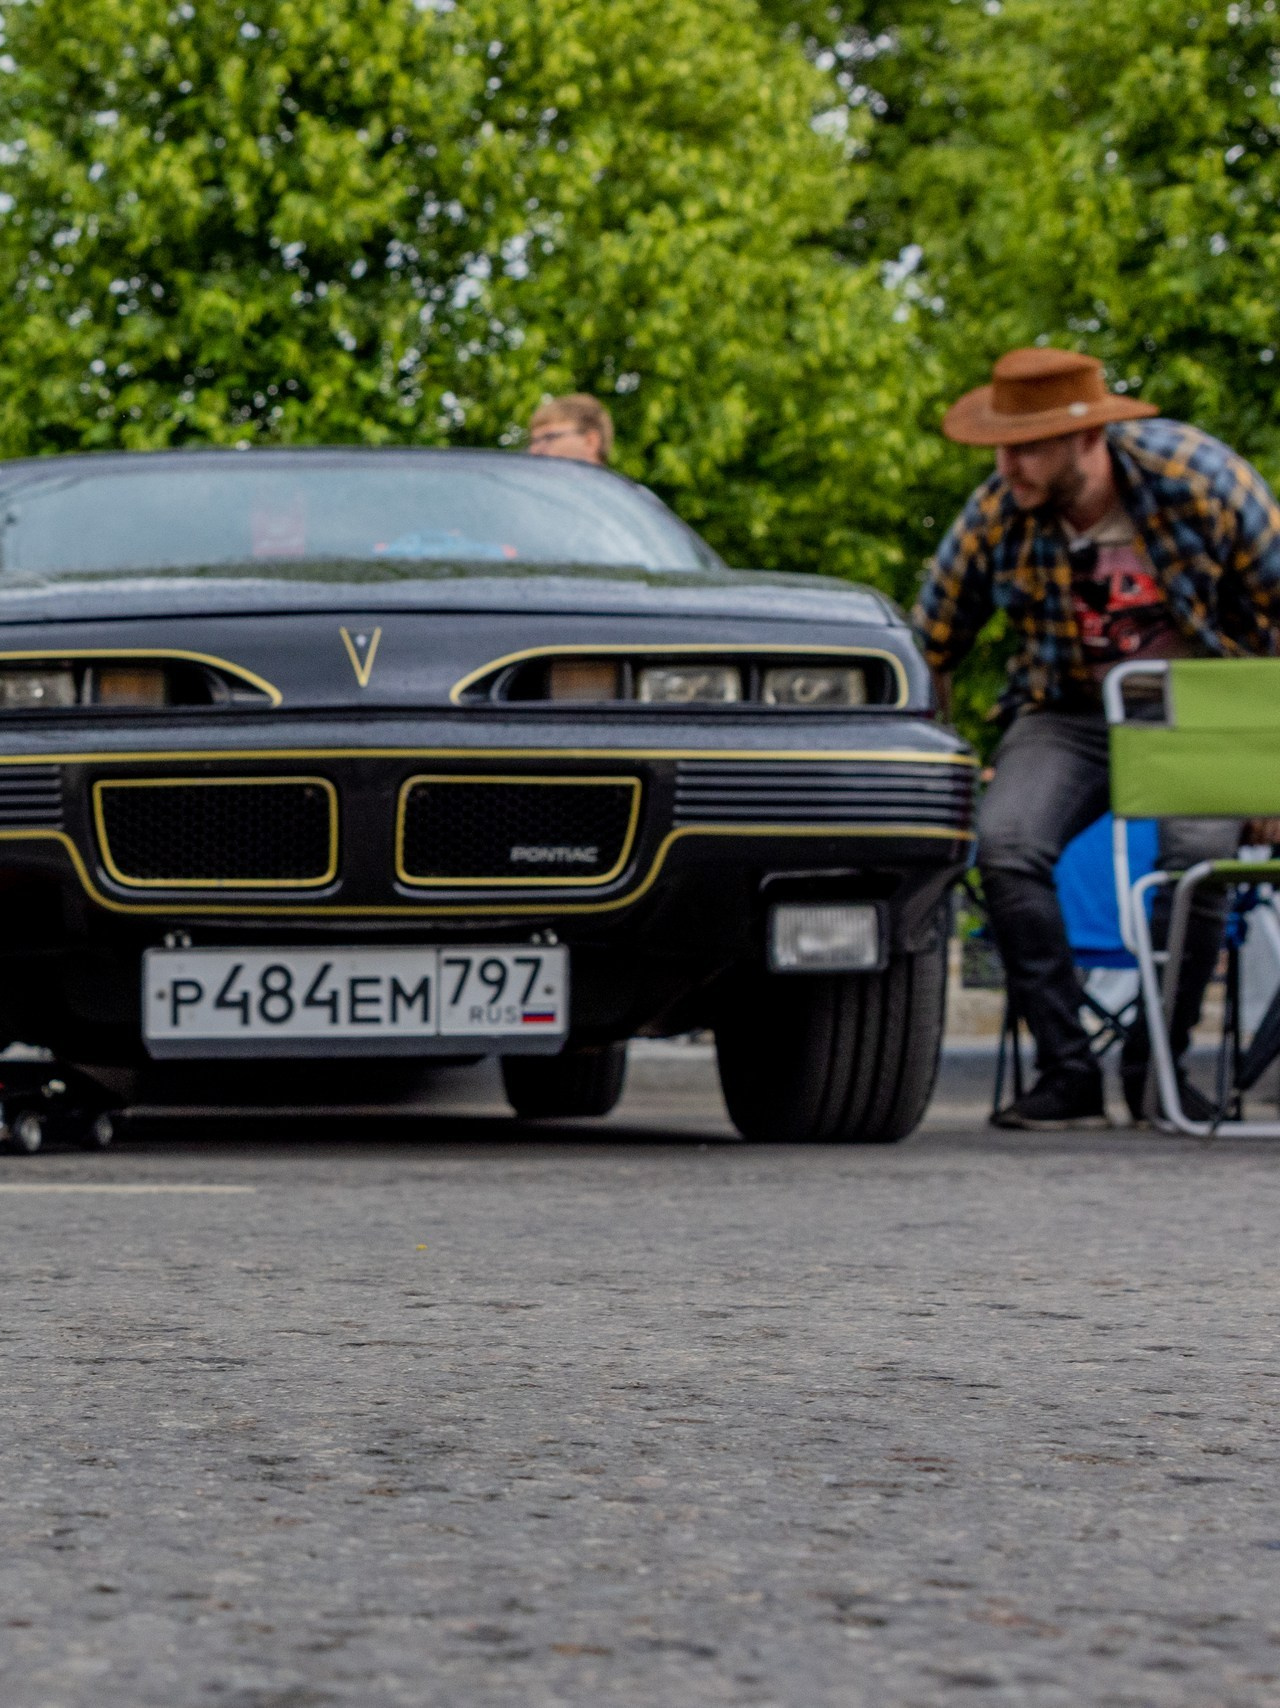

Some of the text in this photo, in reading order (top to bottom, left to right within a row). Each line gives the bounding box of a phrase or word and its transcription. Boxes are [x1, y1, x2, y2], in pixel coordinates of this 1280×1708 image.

[510, 845, 599, 863] PONTIAC
[442, 957, 544, 1007] 797
[469, 1006, 518, 1025] RUS
